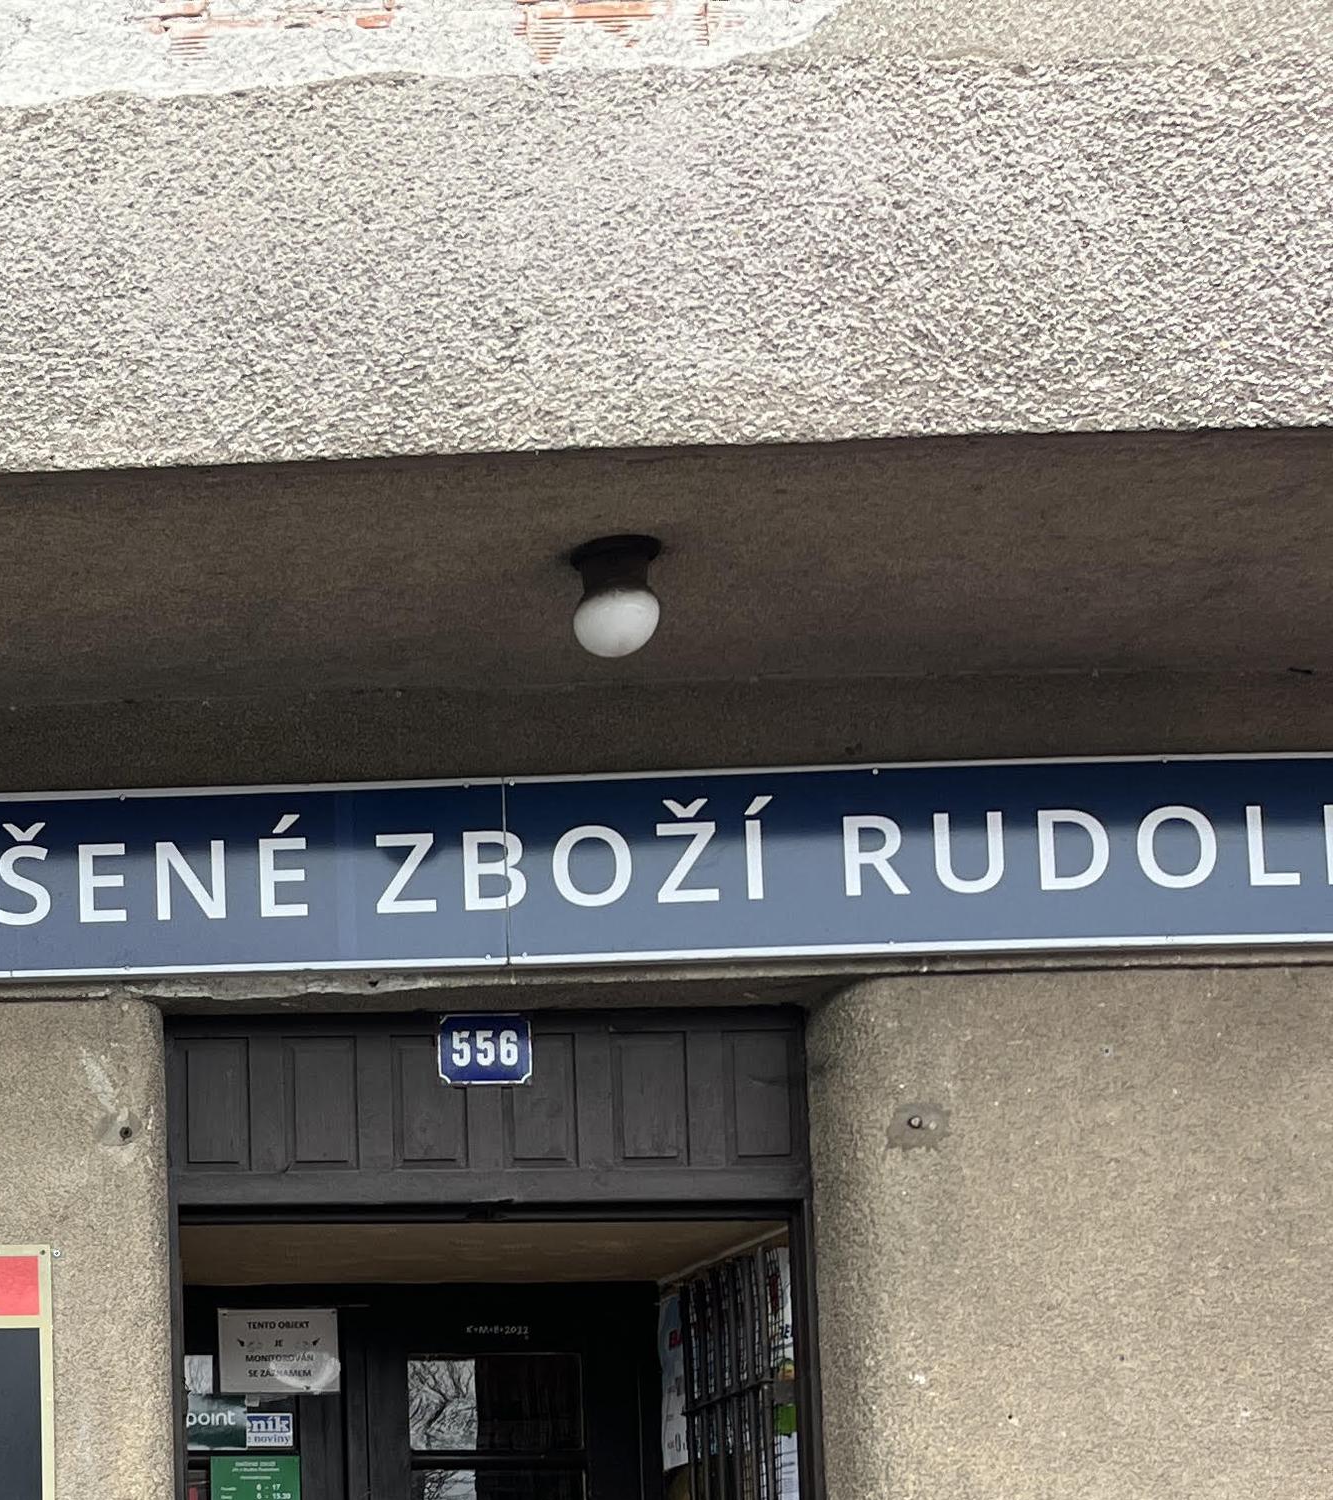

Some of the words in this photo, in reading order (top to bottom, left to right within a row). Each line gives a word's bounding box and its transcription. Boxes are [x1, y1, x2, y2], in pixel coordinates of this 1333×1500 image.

[374, 795, 773, 914] ZBOŽÍ
[452, 1030, 518, 1067] 556
[246, 1321, 276, 1330] TENTO
[278, 1320, 310, 1329] OBJEKT
